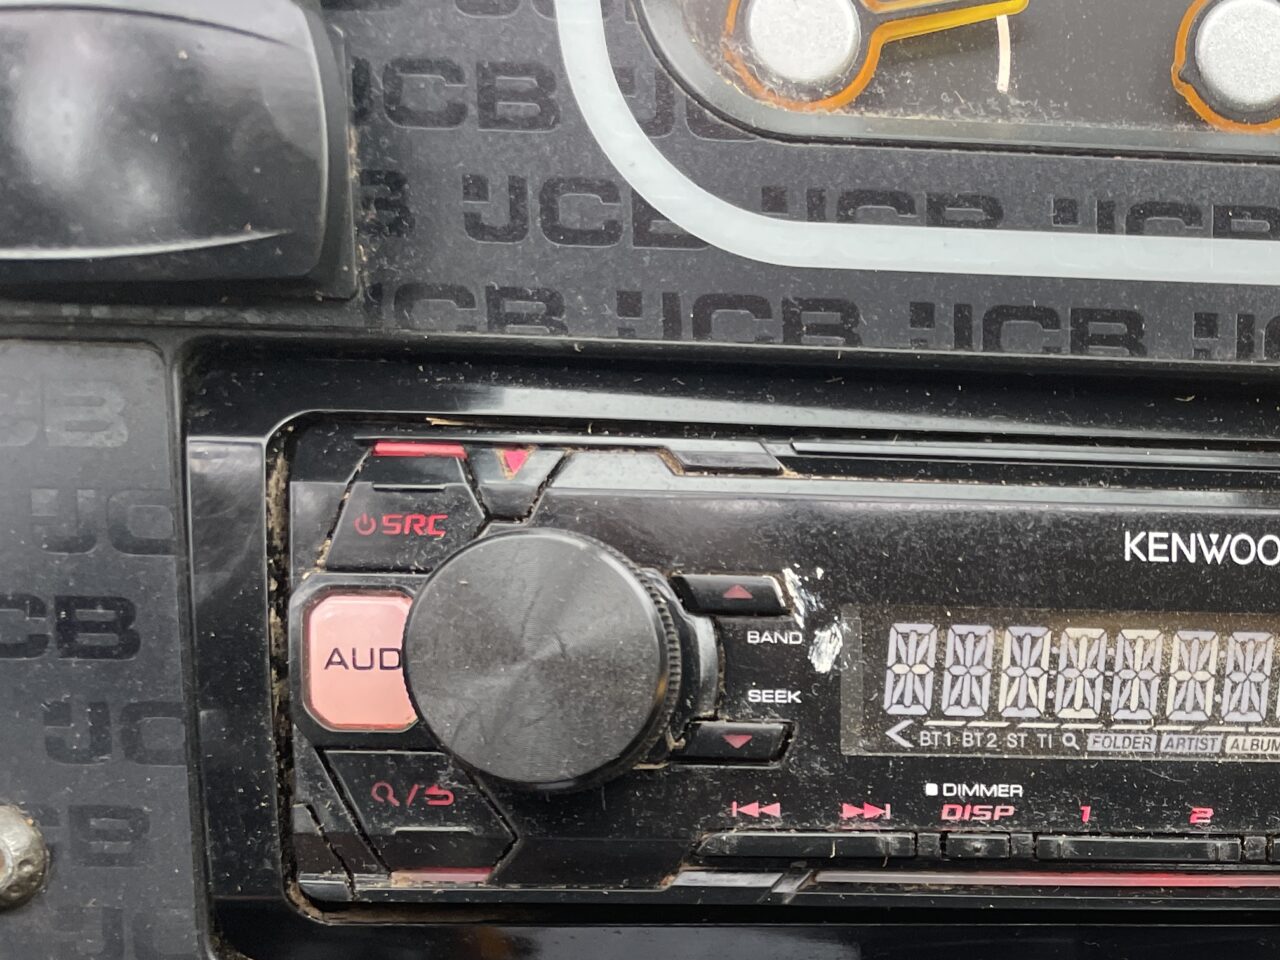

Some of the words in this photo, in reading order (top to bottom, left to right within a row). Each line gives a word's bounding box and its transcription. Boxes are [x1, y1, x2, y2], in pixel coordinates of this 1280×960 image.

[382, 513, 448, 537] SRC
[746, 630, 803, 645] BAND
[324, 647, 402, 671] AUD
[747, 689, 803, 704] SEEK
[919, 731, 952, 747] BT1
[962, 732, 998, 748] BT2
[1006, 732, 1028, 749] ST
[1092, 733, 1153, 751] FOLDER
[1163, 735, 1219, 751] ARTIST
[942, 783, 1024, 797] DIMMER
[941, 804, 1016, 821] DISP
[1079, 805, 1091, 822] 1
[1189, 806, 1214, 823] 2
